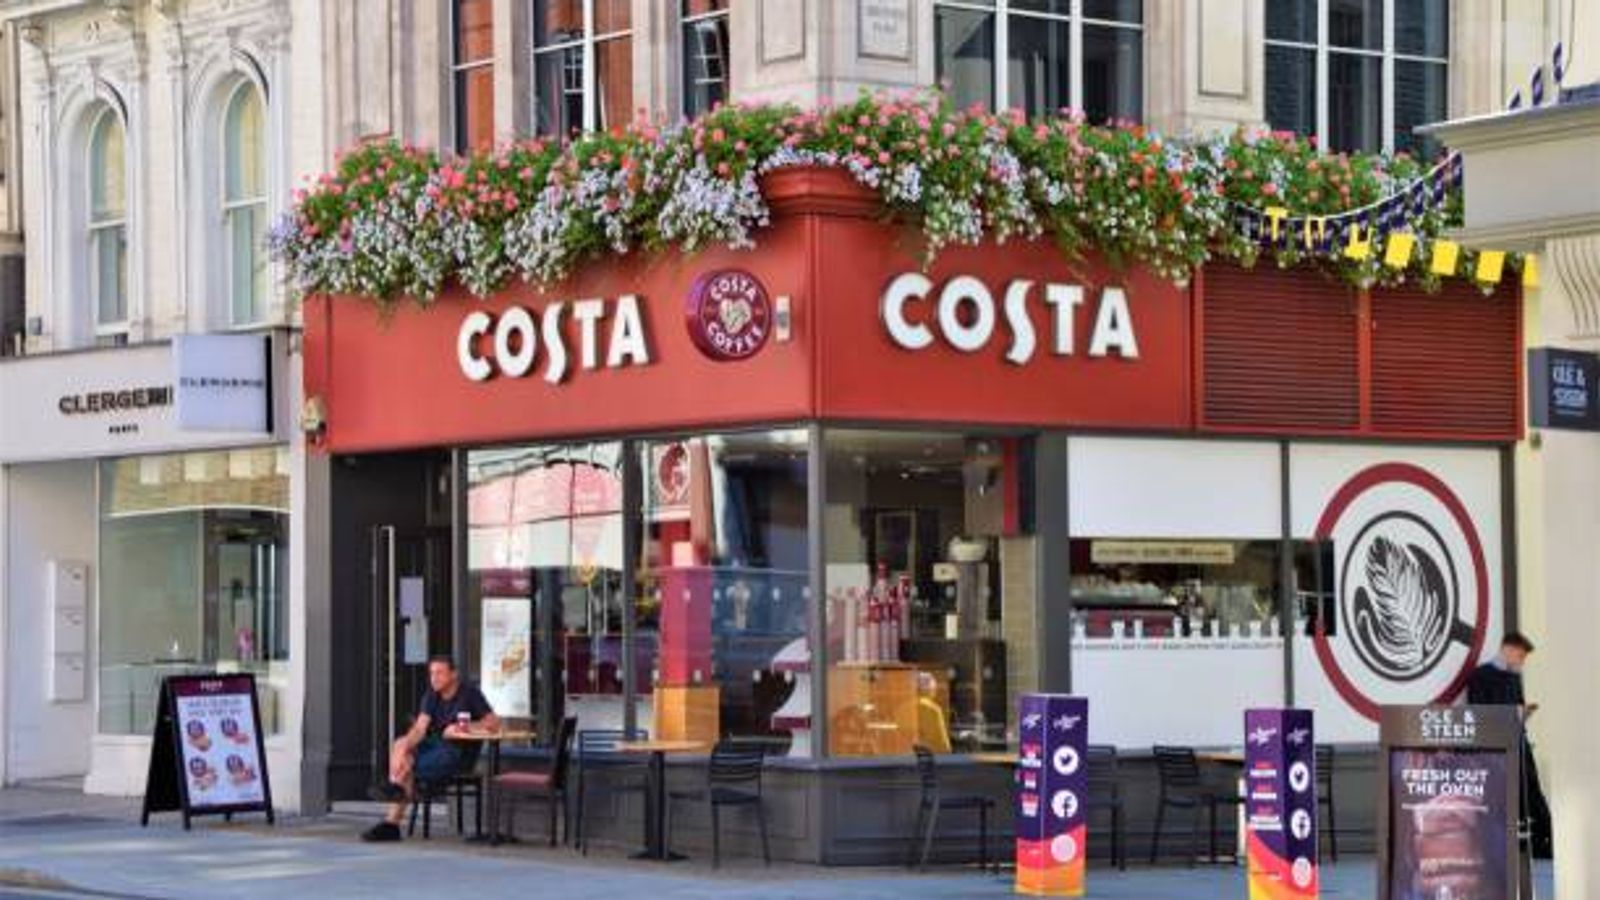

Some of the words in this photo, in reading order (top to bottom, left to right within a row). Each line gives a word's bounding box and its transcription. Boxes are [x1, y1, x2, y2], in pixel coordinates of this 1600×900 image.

[711, 276, 756, 302] COSTA
[883, 272, 1139, 365] COSTA
[457, 294, 649, 384] COSTA
[707, 321, 763, 353] COFFEE
[1401, 768, 1450, 781] FRESH
[1454, 768, 1489, 782] OUT
[1406, 782, 1437, 794] THE
[1440, 782, 1485, 797] OVEN
